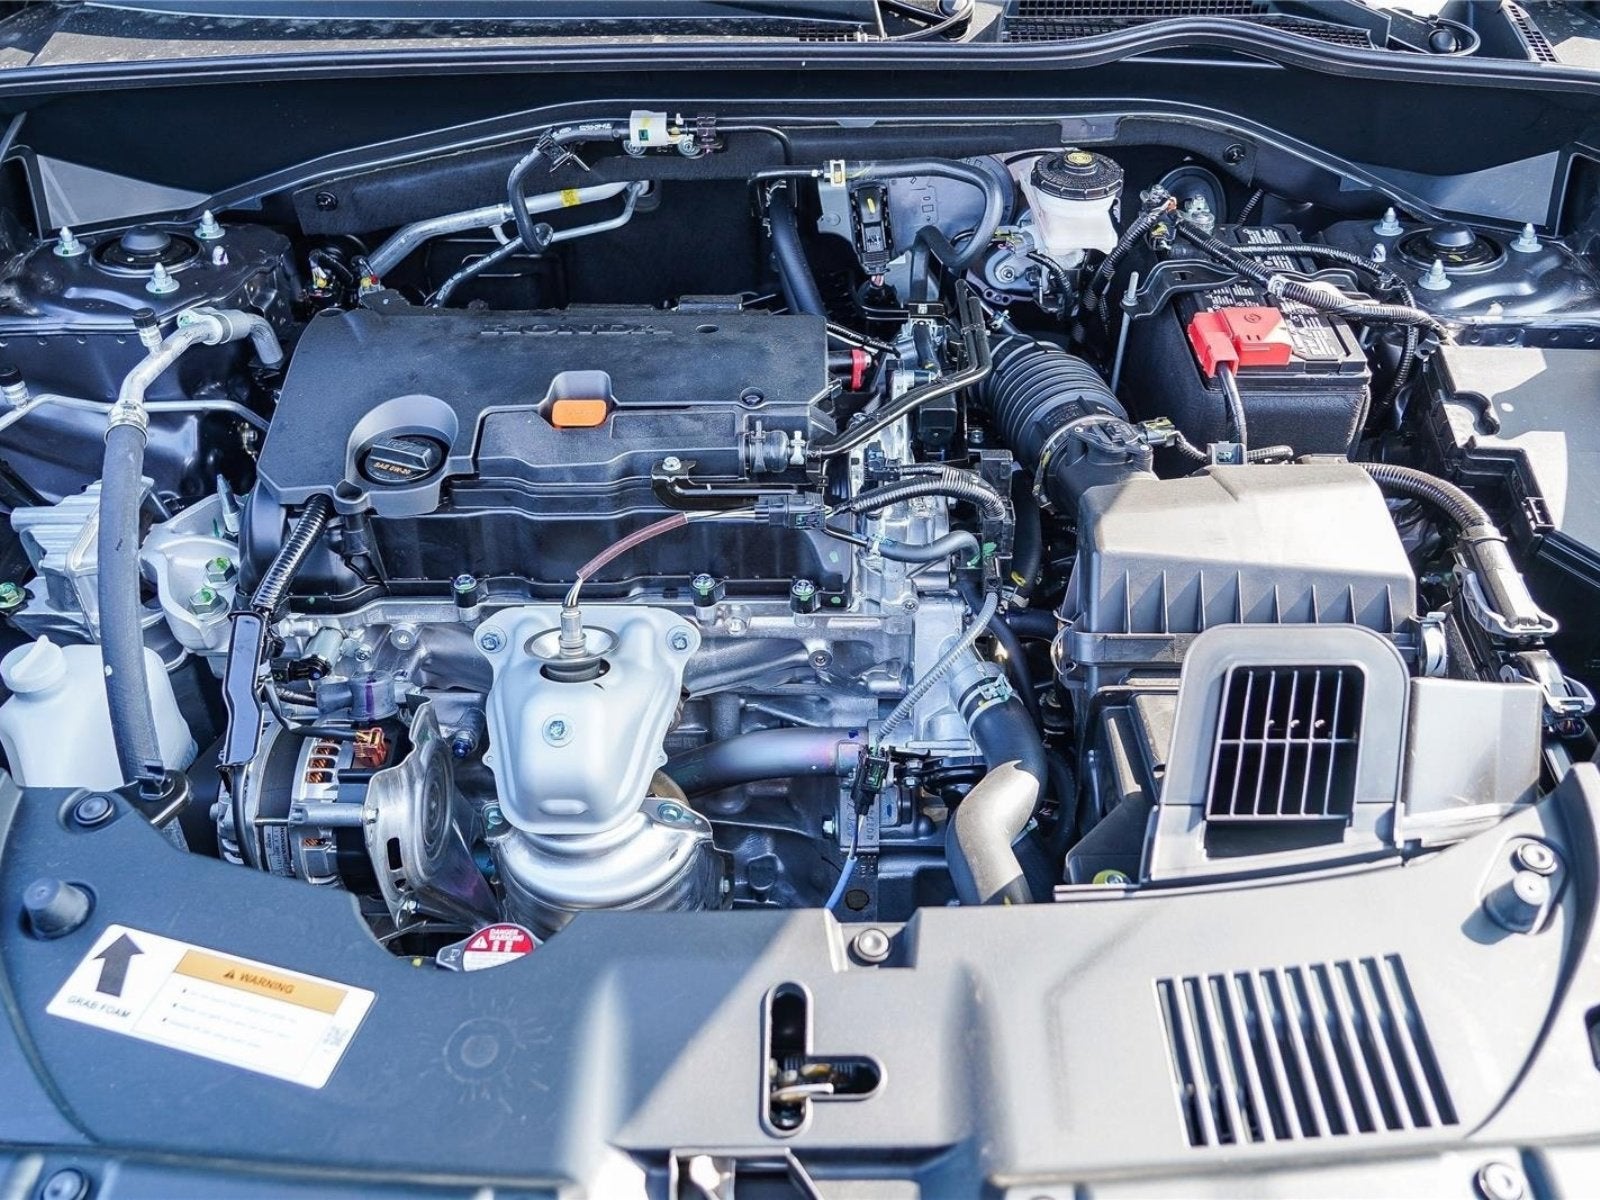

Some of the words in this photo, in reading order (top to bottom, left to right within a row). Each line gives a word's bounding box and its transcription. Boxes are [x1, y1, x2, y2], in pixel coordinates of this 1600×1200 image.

[489, 928, 519, 936] DANGER
[239, 973, 295, 994] WARNING
[67, 995, 98, 1010] GRAB
[101, 1004, 131, 1018] FOAM
